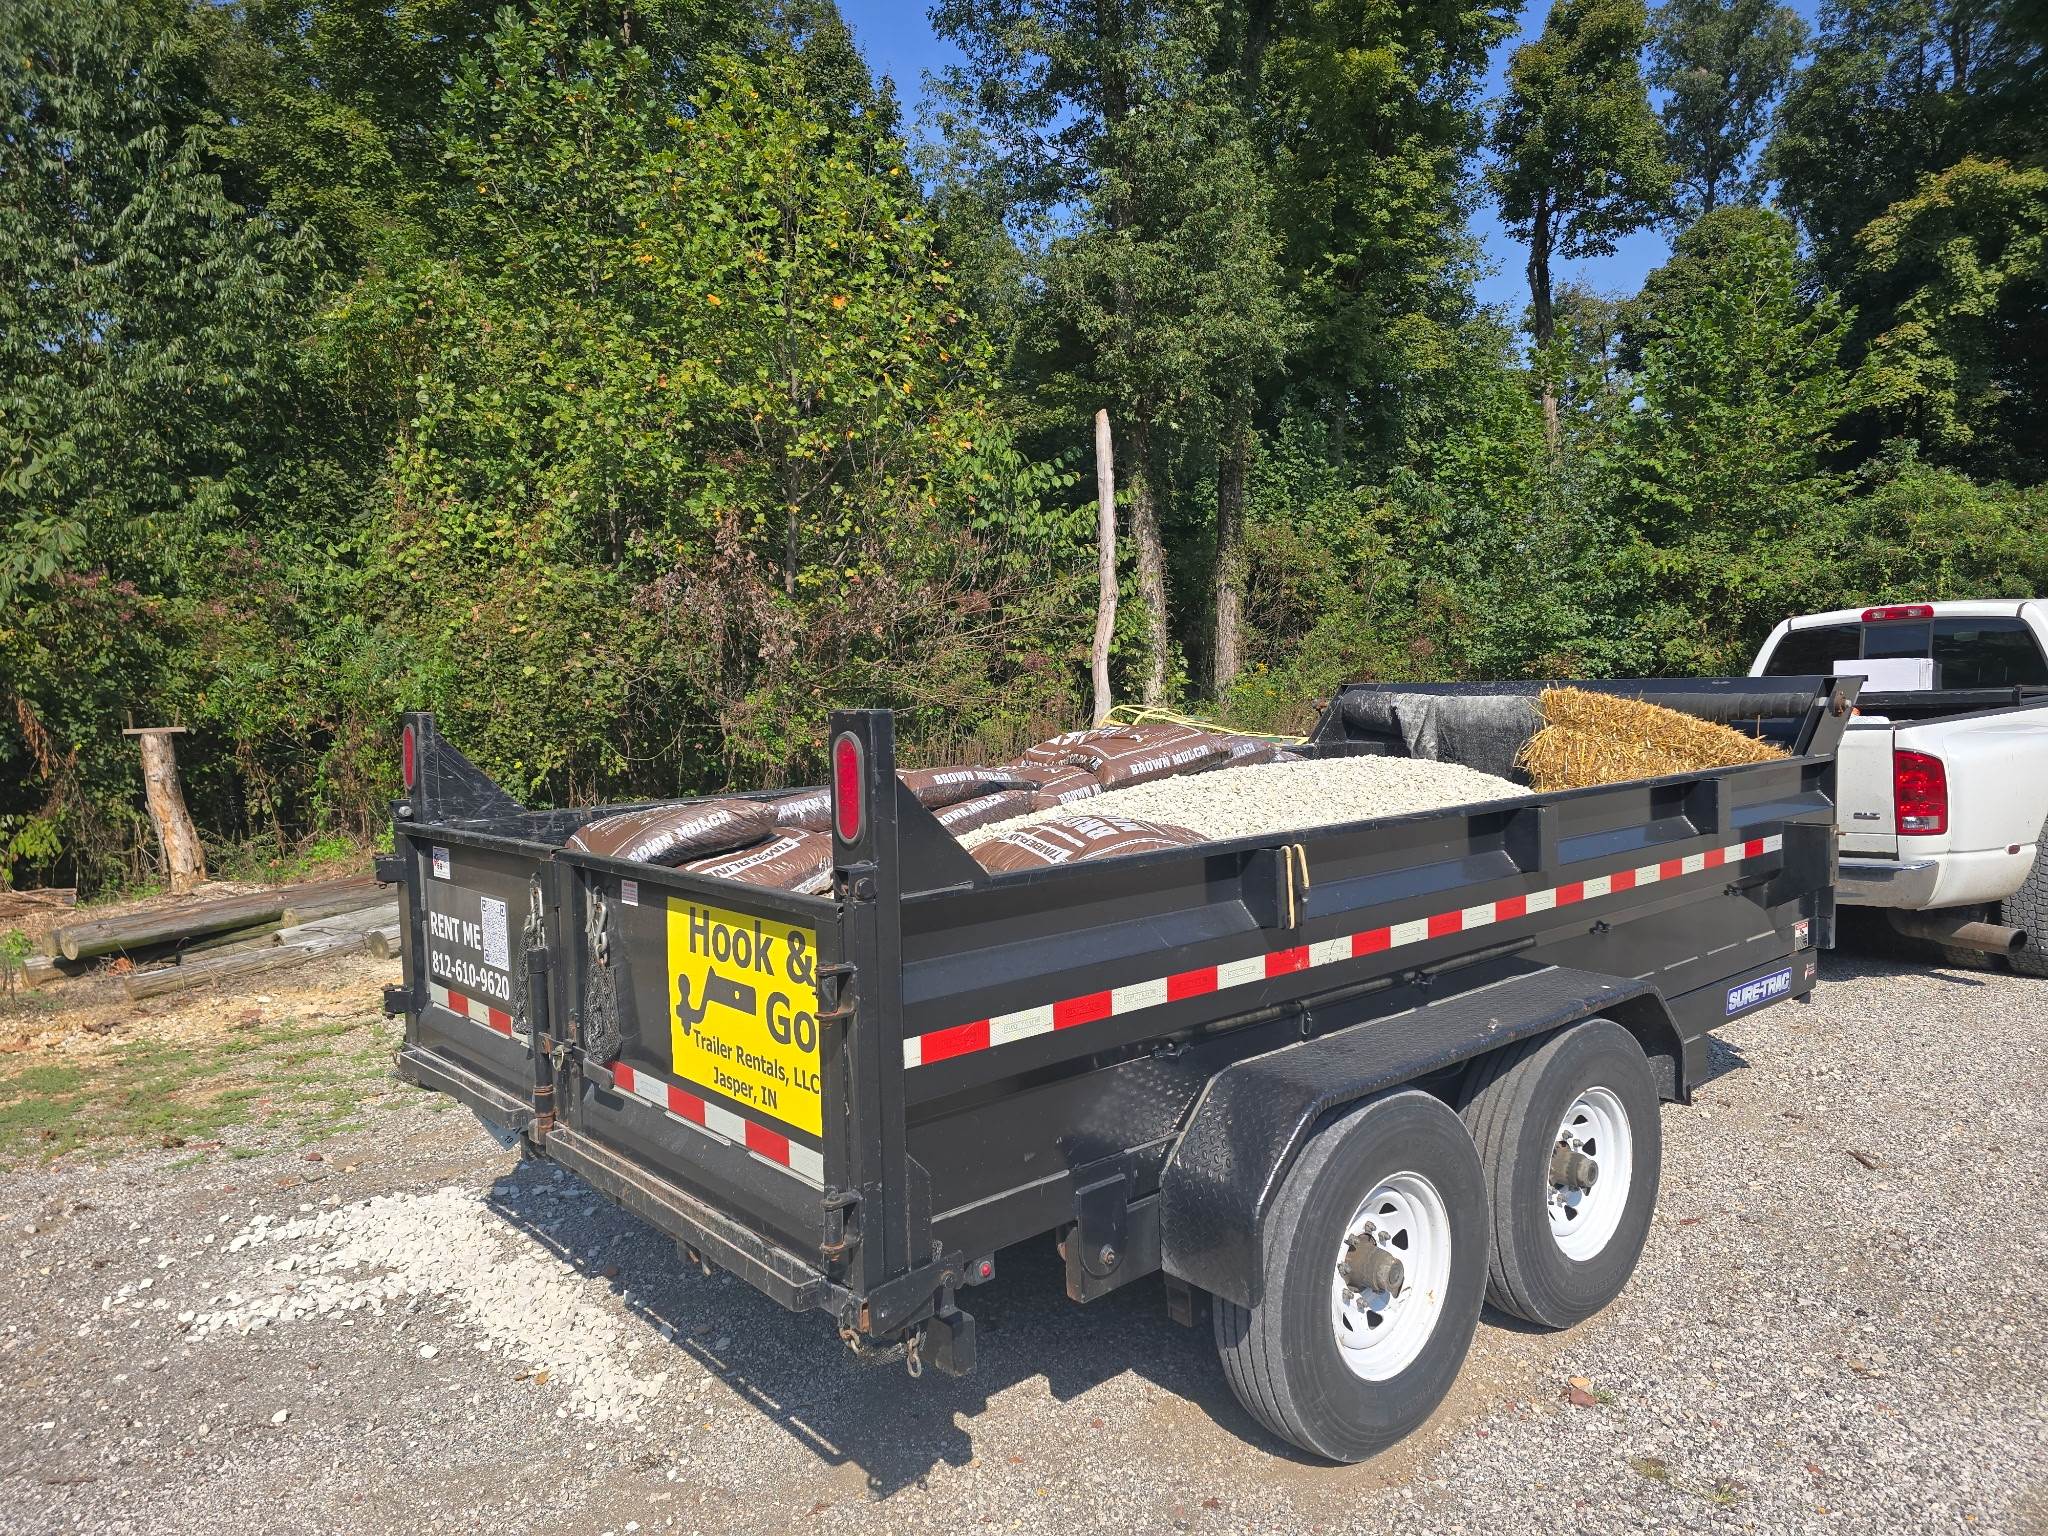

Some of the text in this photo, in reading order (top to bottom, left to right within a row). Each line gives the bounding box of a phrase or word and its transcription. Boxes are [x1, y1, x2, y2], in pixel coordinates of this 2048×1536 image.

[932, 770, 974, 785] BROWN
[1130, 744, 1210, 775] BROWN MULCH
[1057, 785, 1092, 804] BROWN
[430, 911, 482, 950] RENT ME
[689, 906, 817, 987] Hook &
[432, 950, 510, 1000] 812-610-9620
[1728, 971, 1790, 1011] SURE-TRAC
[766, 991, 817, 1054] Go
[693, 1029, 821, 1095] Trailer Rentals, LLC
[713, 1066, 778, 1109] Jasper, IN
